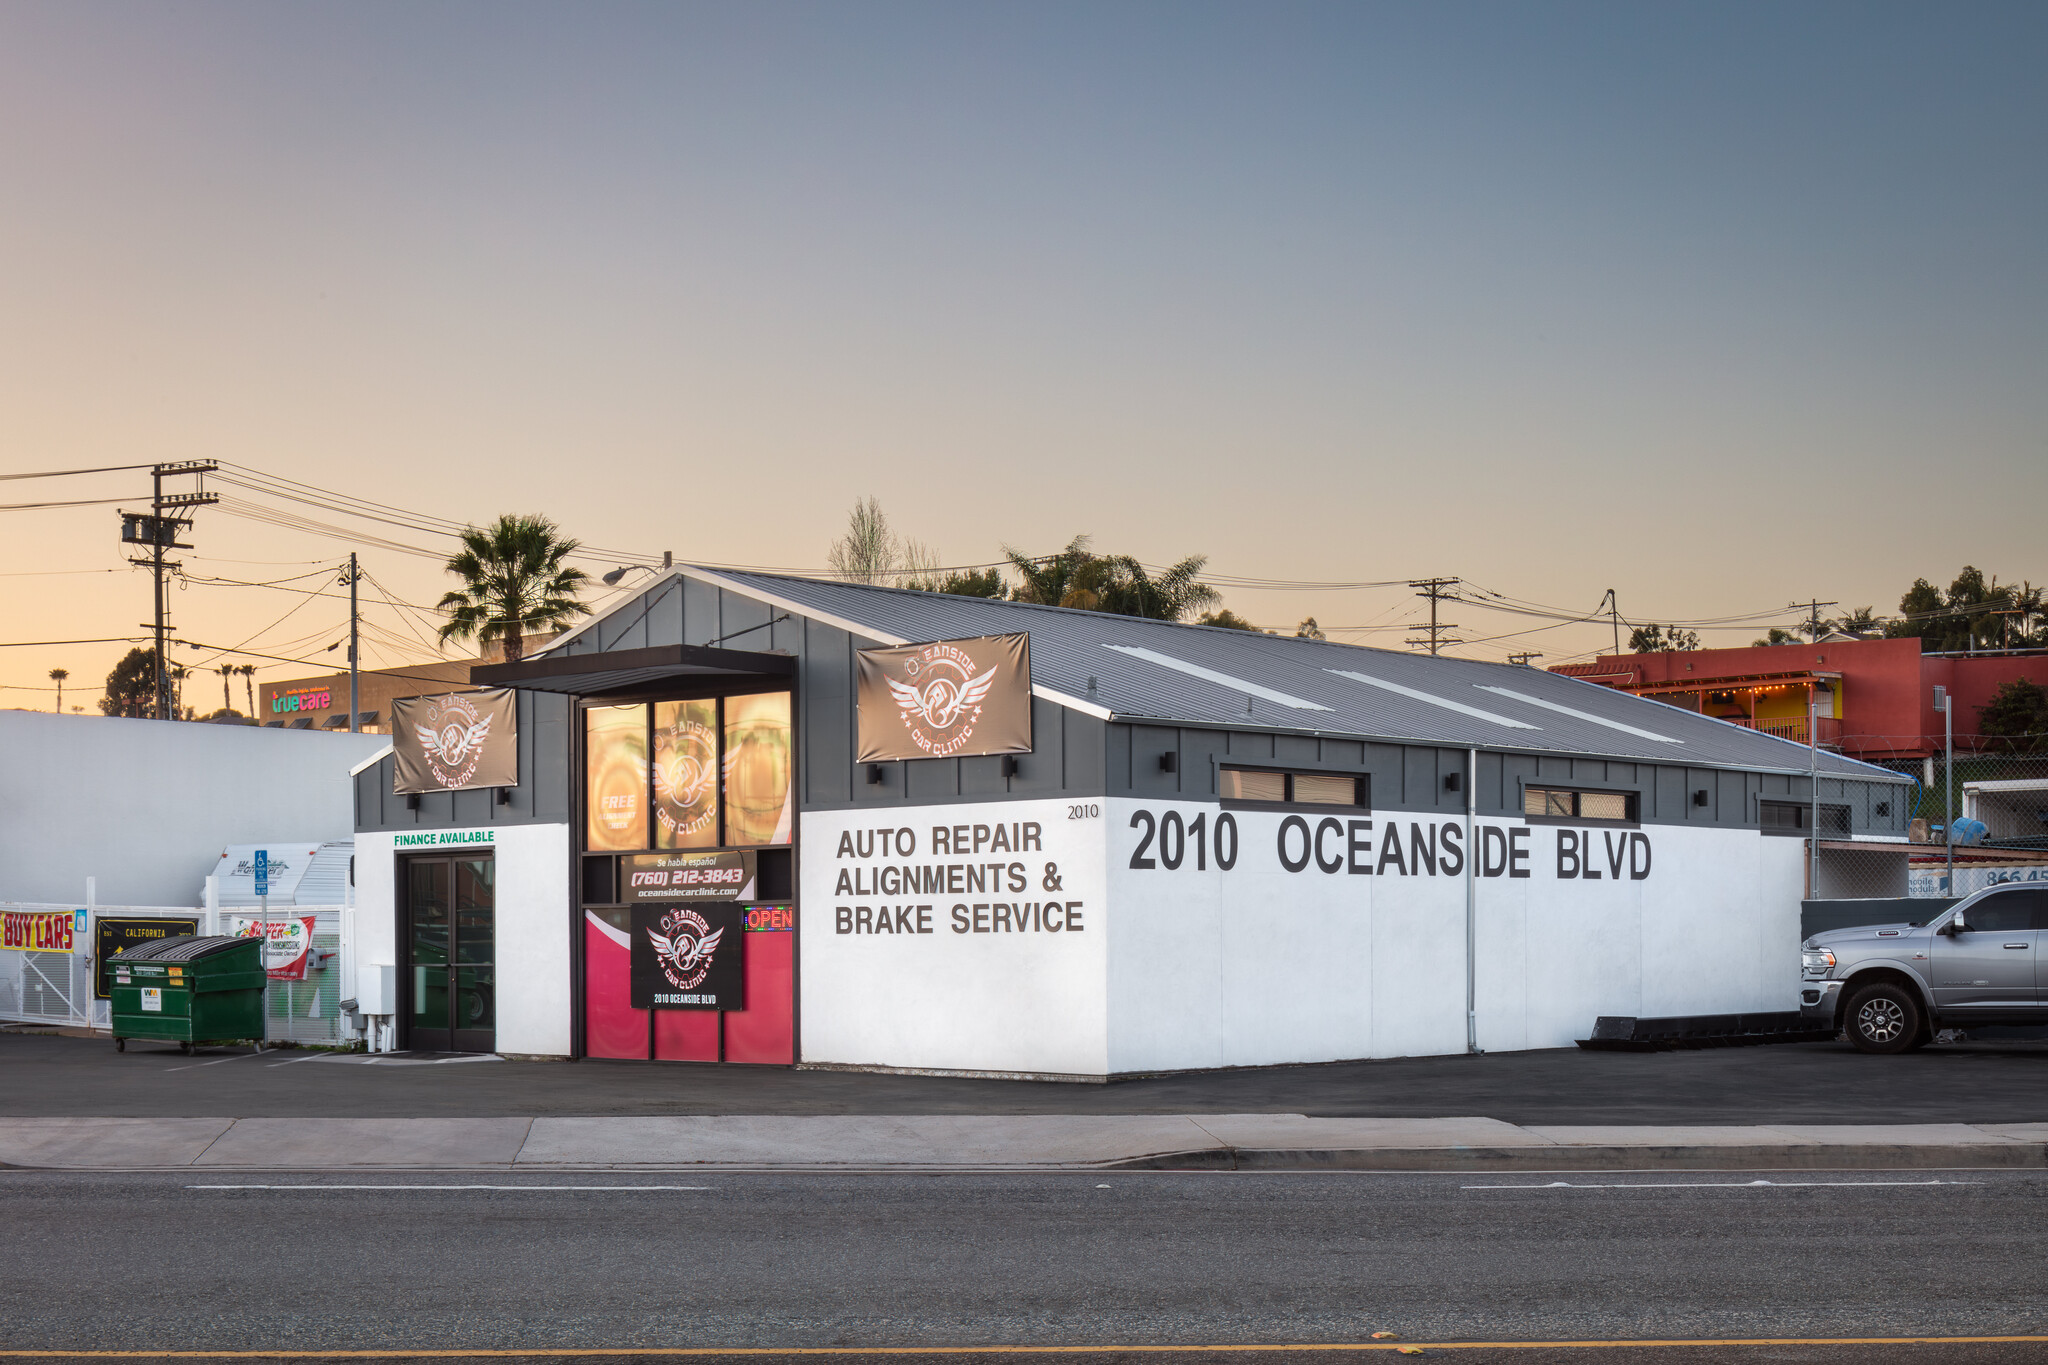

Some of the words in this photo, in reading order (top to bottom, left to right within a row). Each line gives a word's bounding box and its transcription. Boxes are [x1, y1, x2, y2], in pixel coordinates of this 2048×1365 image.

[272, 692, 331, 712] truecare
[911, 727, 932, 752] CAR
[933, 724, 973, 754] CLINIC
[432, 766, 447, 786] CAR
[447, 763, 476, 788] CLINIC
[601, 794, 636, 810] FREE
[1067, 803, 1099, 820] 2010
[656, 806, 676, 833] CAR
[677, 803, 717, 835] CLINIC
[394, 833, 437, 846] FINANCE
[439, 830, 495, 844] AVAILABLE
[836, 827, 917, 859] AUTO
[932, 821, 1042, 855] REPAIR
[1129, 809, 1239, 871] 2010
[1277, 815, 1531, 878] OCEANSIDE
[1557, 829, 1652, 881] BLVD
[656, 858, 666, 867] Se
[688, 856, 717, 868] español
[631, 871, 669, 887] (760)
[671, 868, 743, 885] 212-3843
[835, 861, 1028, 896] ALIGNMENTS
[1042, 861, 1063, 892] &
[637, 887, 738, 898] oceansidecarclinic.com
[748, 911, 792, 928] OPEN
[835, 904, 934, 935] BRAKE
[951, 901, 1084, 934] SERVICE
[4, 914, 35, 947] BUY
[35, 914, 73, 949] CARS
[125, 928, 166, 938] CALIFORNIA
[664, 968, 679, 987] CAR
[679, 969, 707, 989] CLINIC
[144, 989, 158, 997] WM
[654, 994, 669, 1004] 2010
[670, 994, 700, 1004] OCEANSIDE
[701, 995, 717, 1004] BLVD
